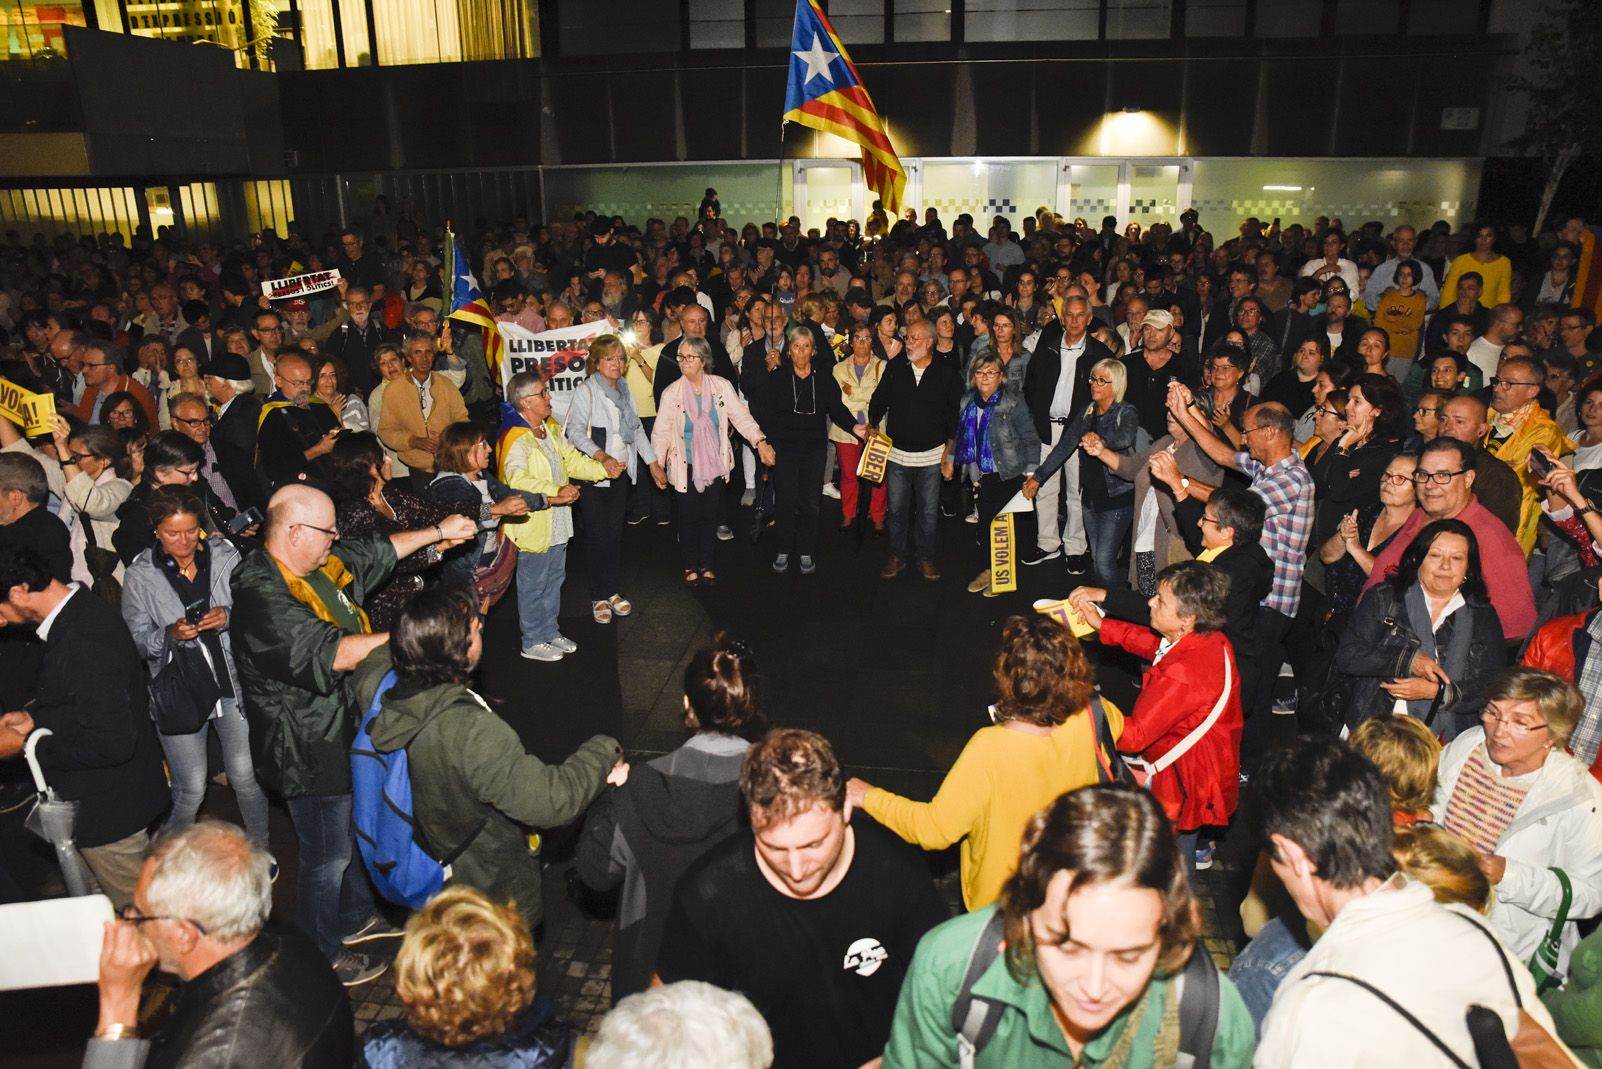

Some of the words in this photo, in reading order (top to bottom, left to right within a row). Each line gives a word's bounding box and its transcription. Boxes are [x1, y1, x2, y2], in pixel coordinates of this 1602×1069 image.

[510, 354, 586, 374] PRESO
[994, 526, 1009, 567] VOLEM
[995, 569, 1010, 585] US
